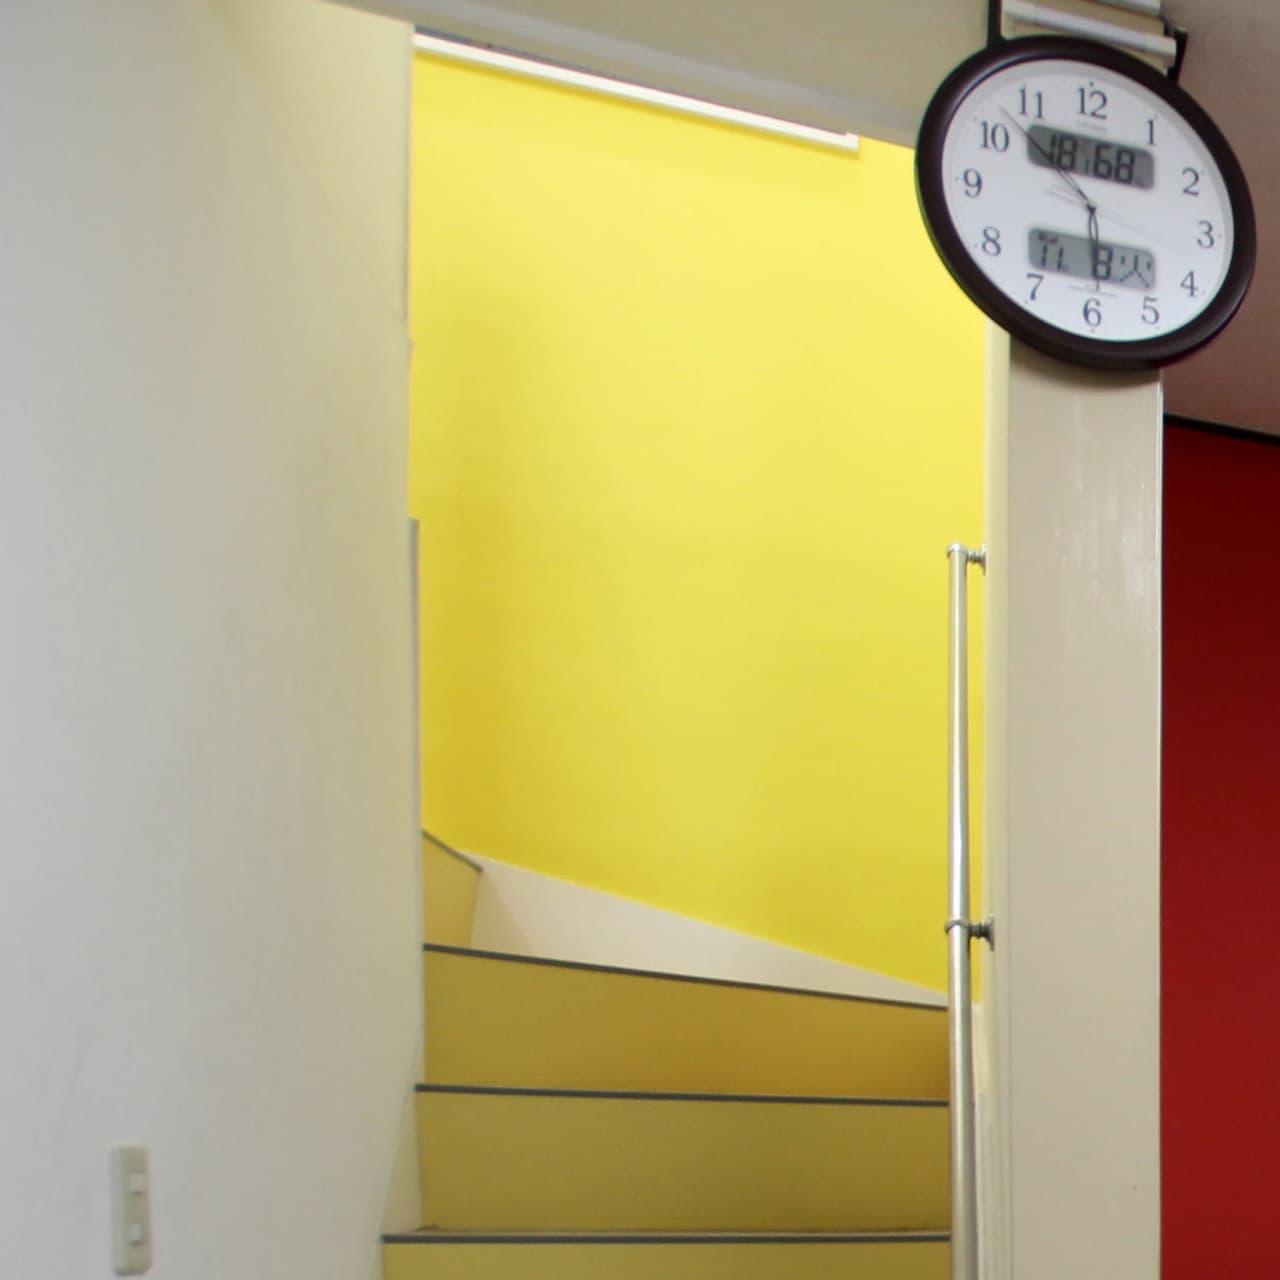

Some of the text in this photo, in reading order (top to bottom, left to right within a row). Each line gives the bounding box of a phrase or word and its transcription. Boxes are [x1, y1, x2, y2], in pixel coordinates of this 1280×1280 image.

[1018, 87, 1045, 120] 11
[1076, 87, 1108, 120] 12
[980, 120, 1010, 153] 10
[1145, 119, 1157, 147] 1
[962, 168, 983, 198] 9
[1181, 167, 1200, 197] 2
[981, 226, 1003, 257] 8
[1196, 219, 1216, 250] 3
[1025, 272, 1045, 302] 7
[1179, 270, 1199, 298] 4
[1081, 298, 1102, 328] 6
[1140, 296, 1161, 326] 5
